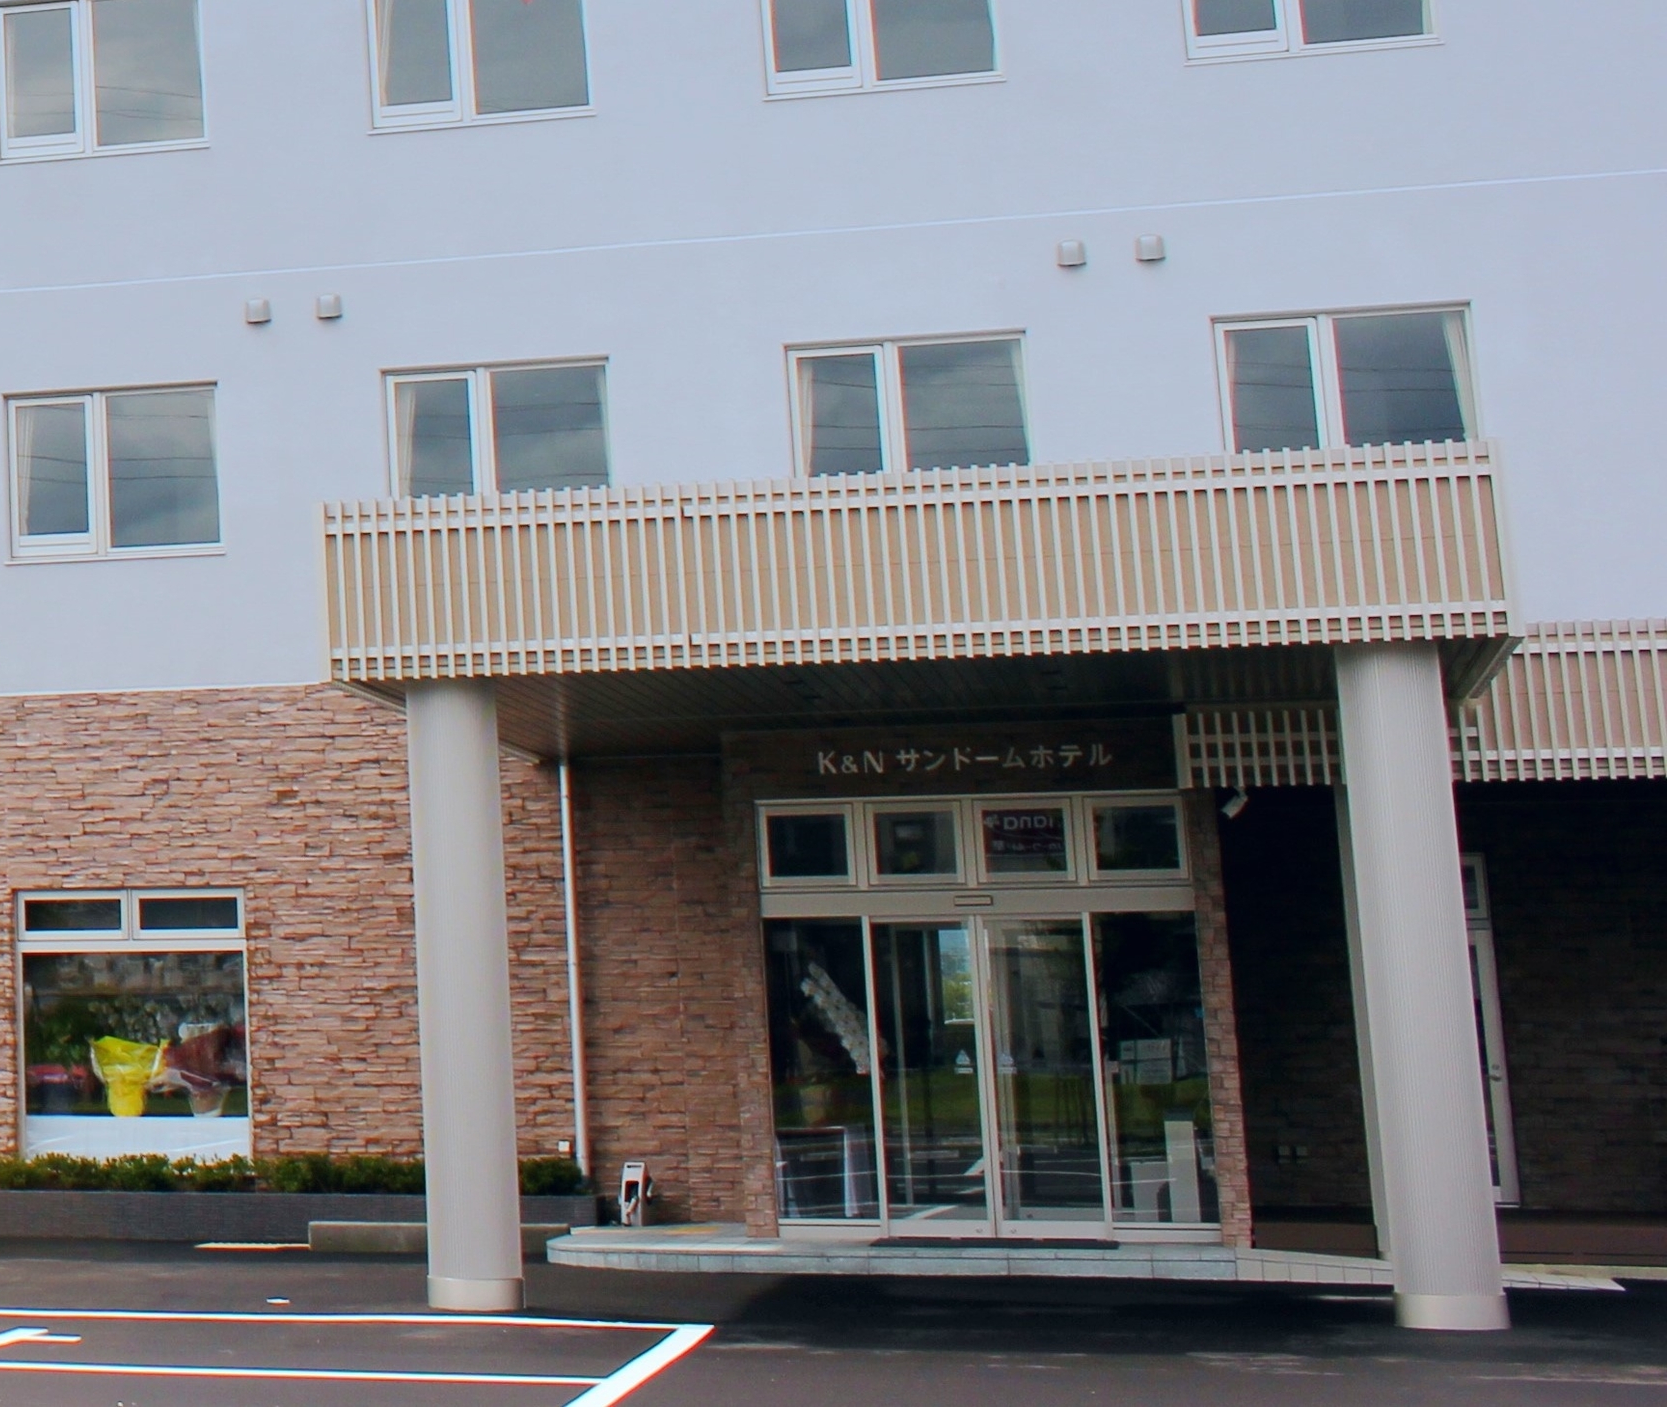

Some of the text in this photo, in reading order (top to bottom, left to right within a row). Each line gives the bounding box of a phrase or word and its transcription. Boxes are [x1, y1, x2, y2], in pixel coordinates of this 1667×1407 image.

[818, 743, 1113, 775] K&N サンドームホテル
